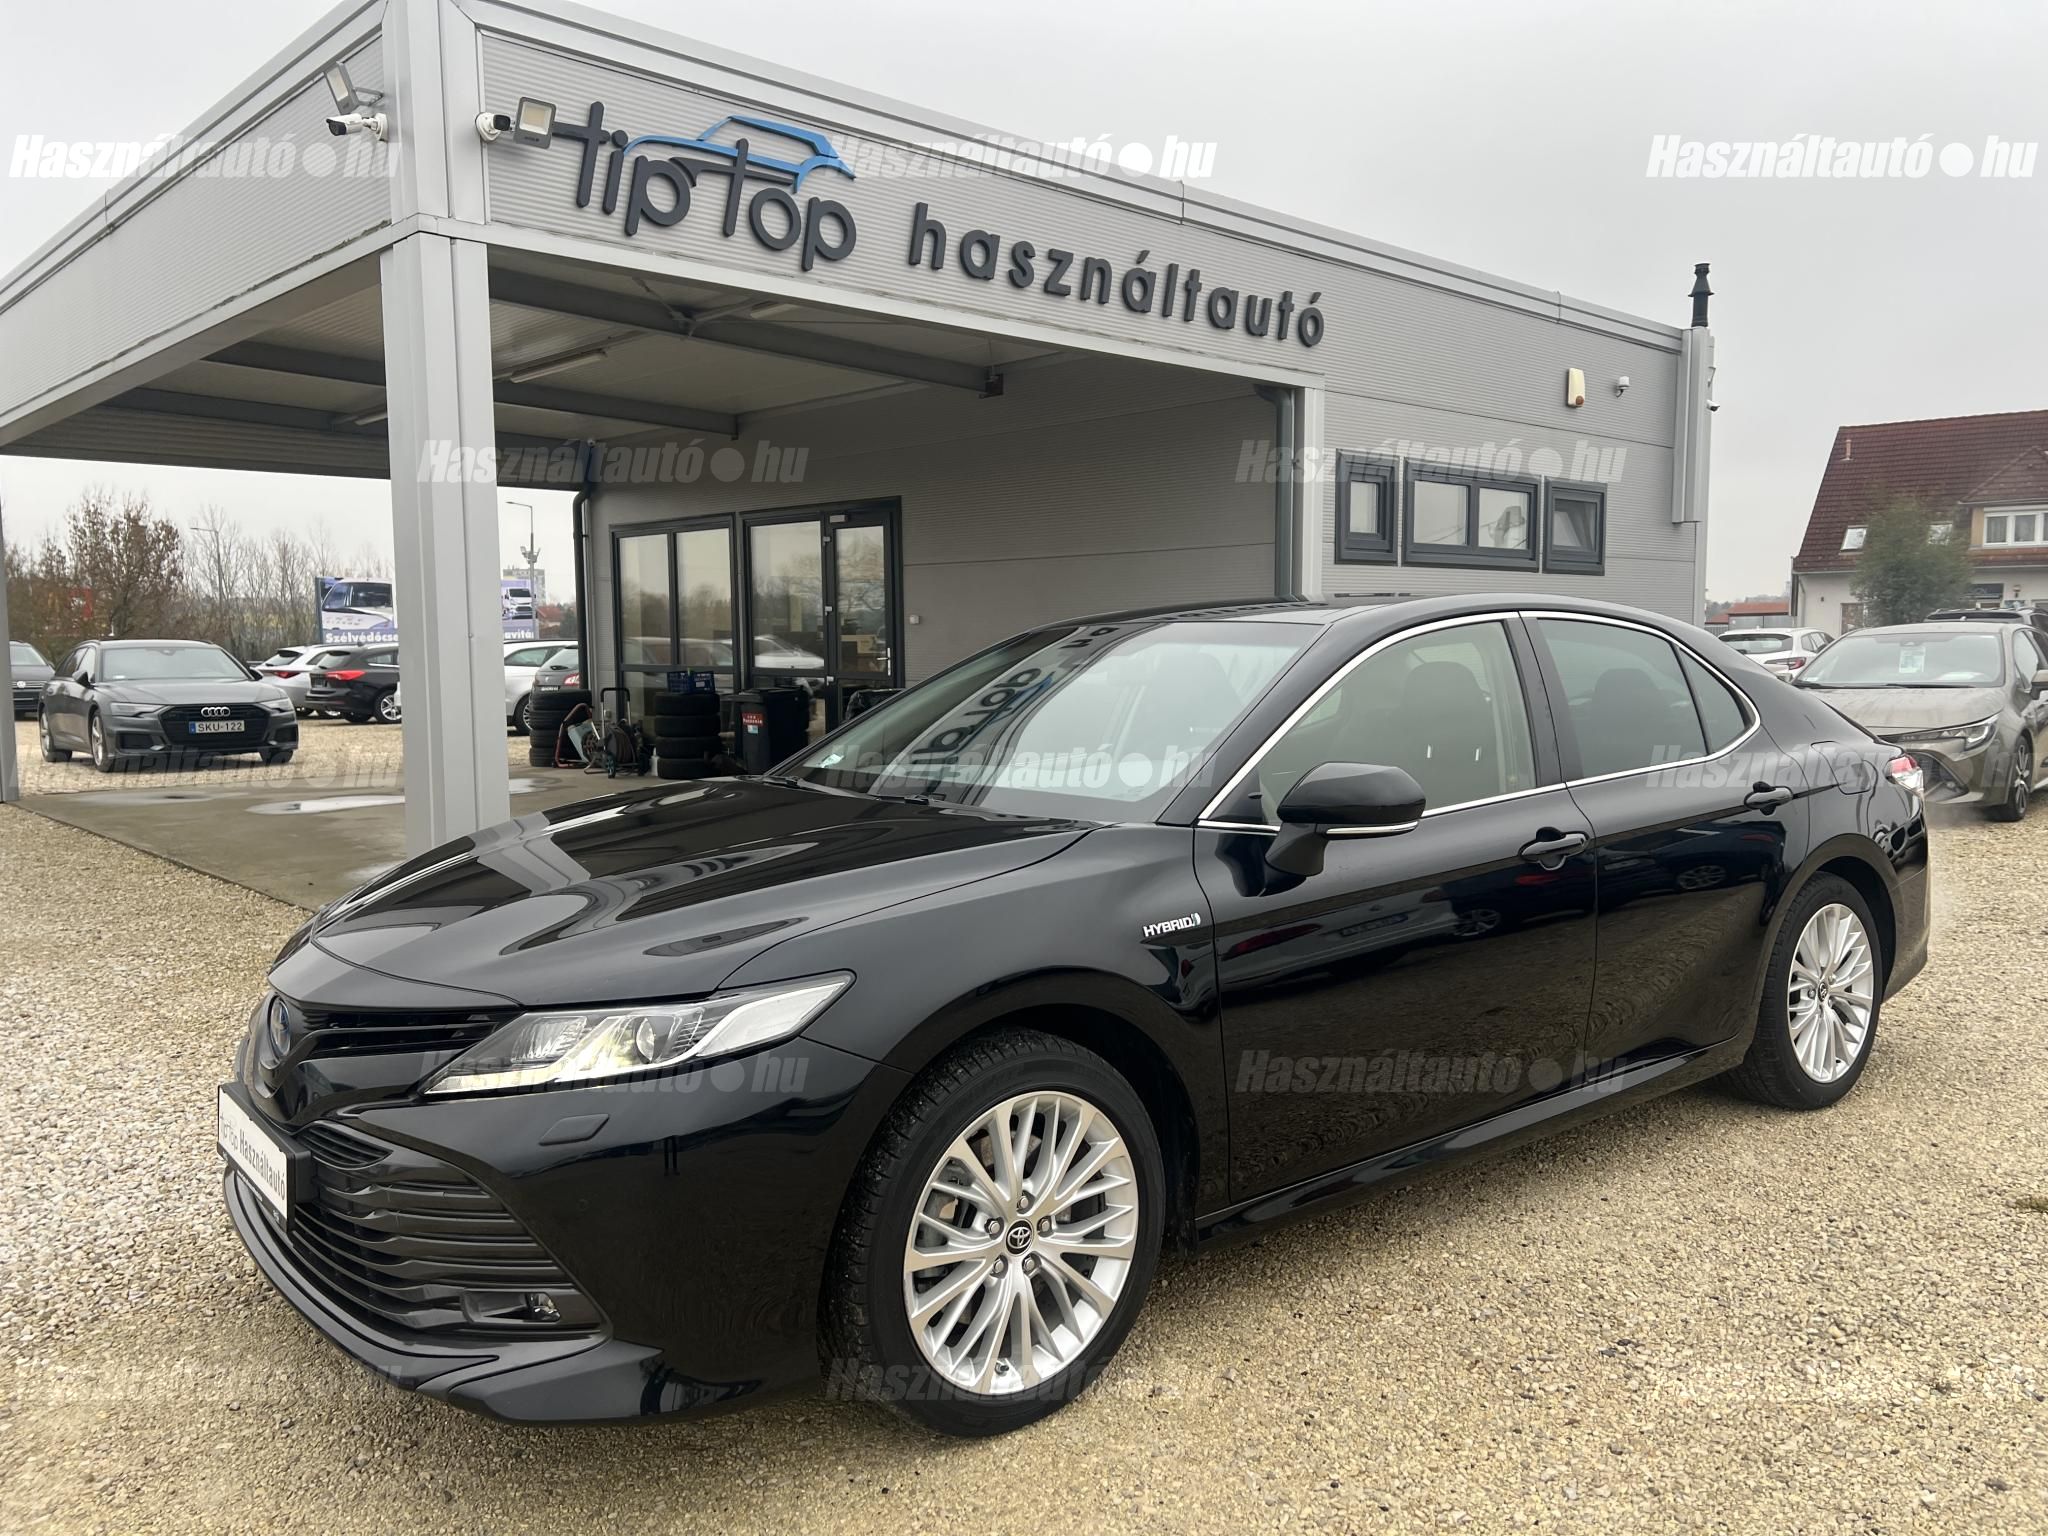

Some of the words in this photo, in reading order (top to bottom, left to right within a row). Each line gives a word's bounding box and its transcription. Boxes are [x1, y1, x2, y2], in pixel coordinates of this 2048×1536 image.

[908, 202, 1324, 348] használtautó
[198, 722, 242, 732] SKU-122
[1143, 917, 1192, 937] HYBRID
